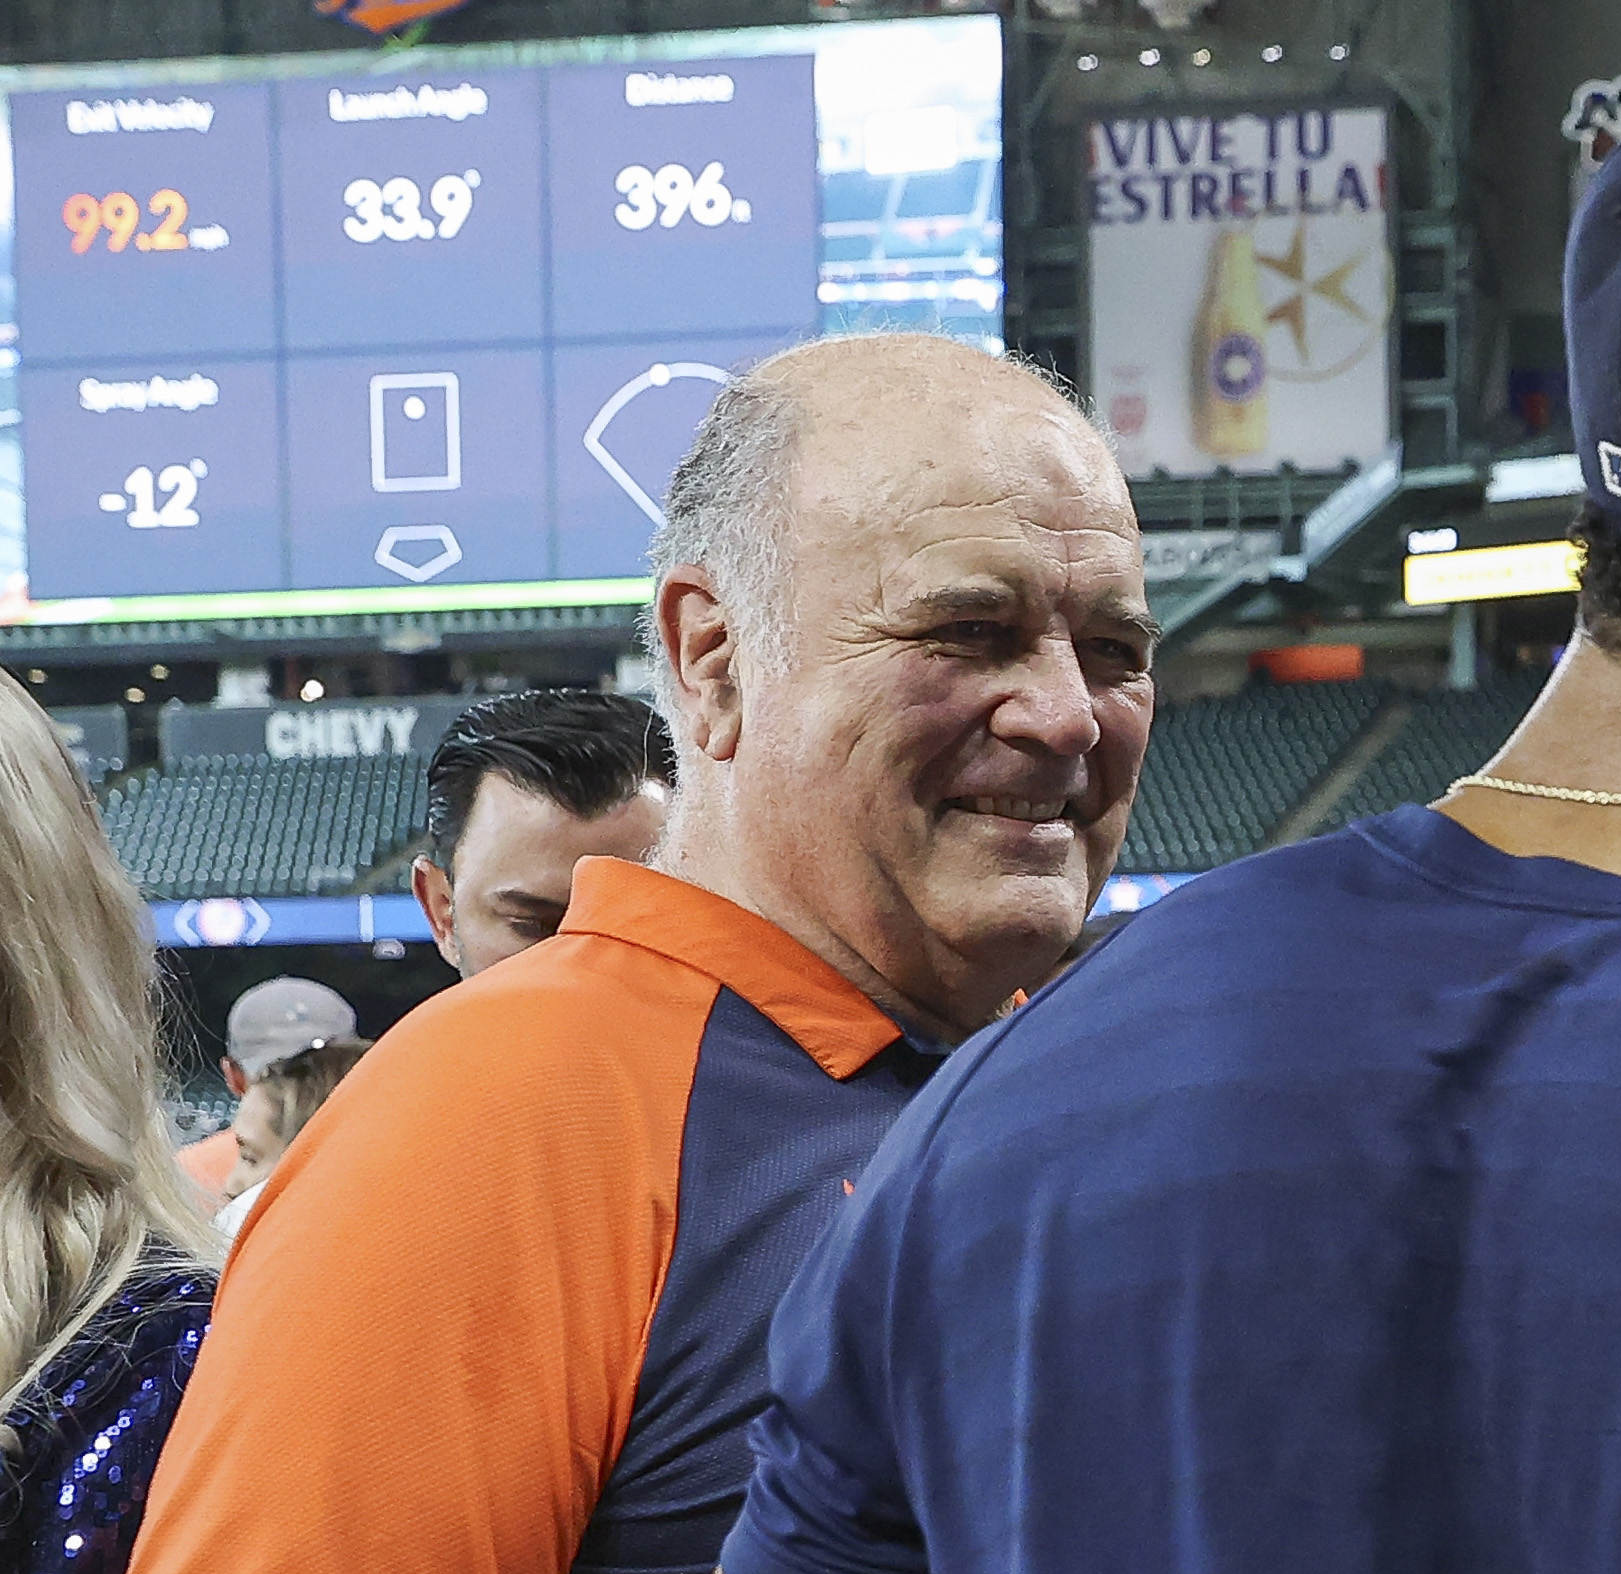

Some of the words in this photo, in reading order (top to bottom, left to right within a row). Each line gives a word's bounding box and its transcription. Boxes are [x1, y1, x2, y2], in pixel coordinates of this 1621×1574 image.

[1255, 108, 1331, 162] TU
[62, 188, 189, 254] 99.2
[266, 706, 420, 759] CHEVY
